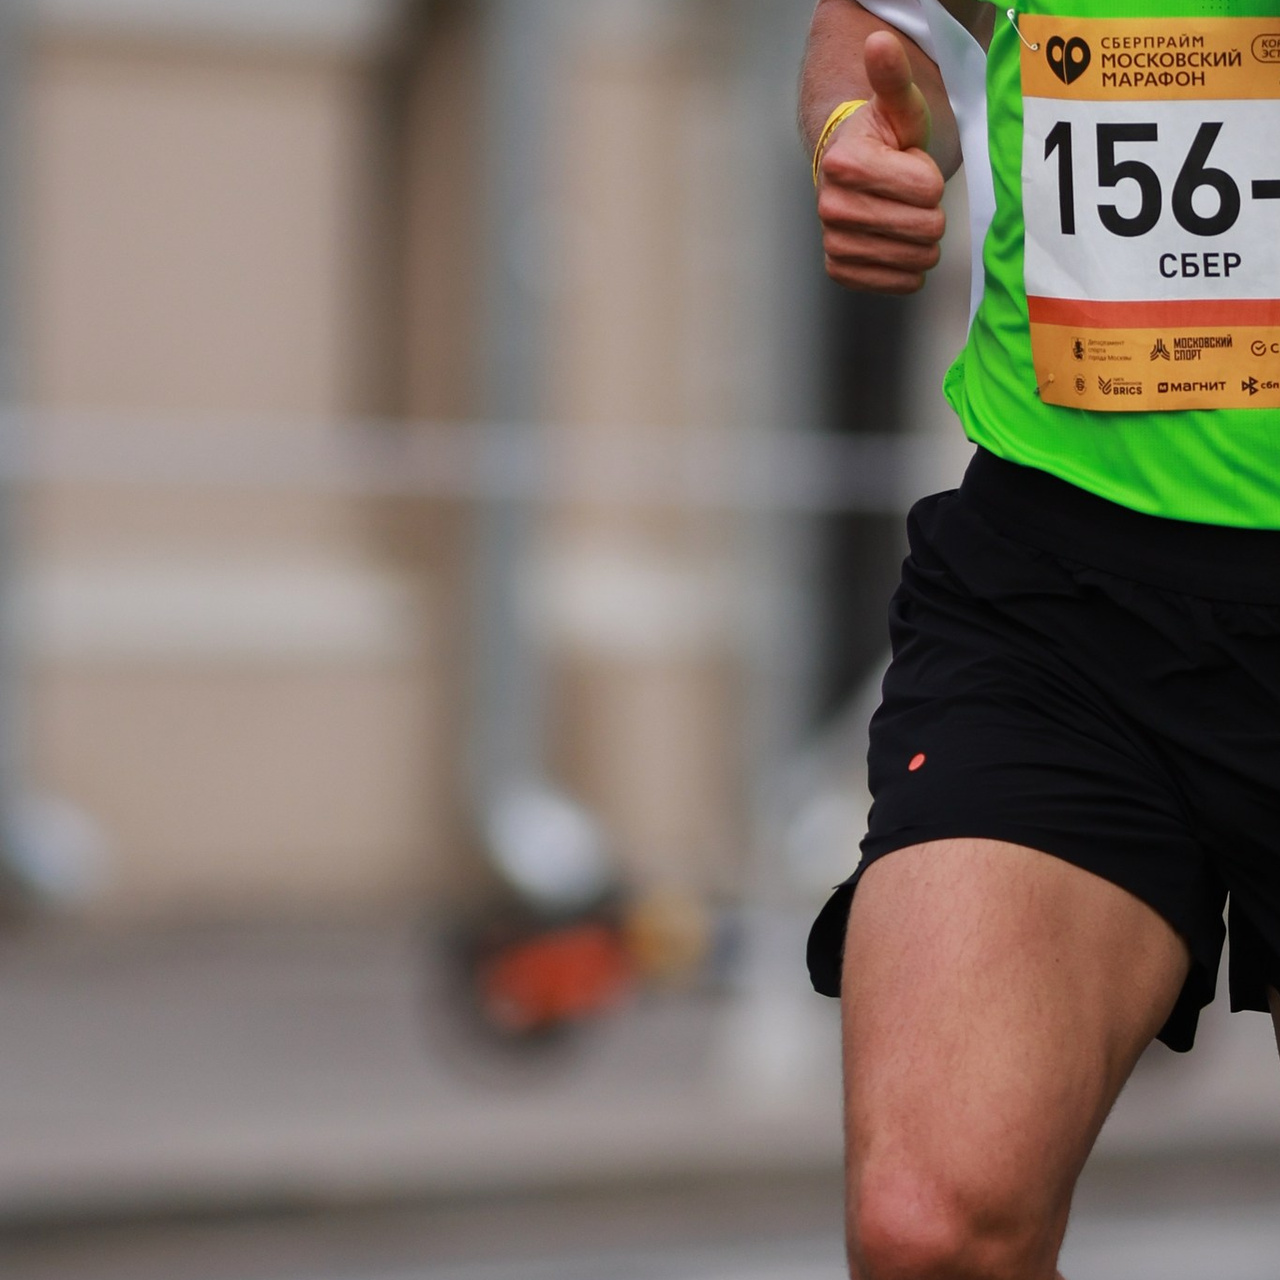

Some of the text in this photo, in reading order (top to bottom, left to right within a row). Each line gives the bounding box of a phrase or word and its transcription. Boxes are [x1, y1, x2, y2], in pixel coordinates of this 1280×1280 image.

[1101, 33, 1204, 49] СБЕРПРАЙМ
[1101, 48, 1242, 68] МОСКОВСКИЙ
[1102, 71, 1205, 87] МАРАФОН
[1159, 252, 1242, 278] СБЕР
[1173, 334, 1233, 349] МОСКОВСКИЙ
[1173, 349, 1202, 361] СПОРТ
[1113, 386, 1142, 395] BRICS
